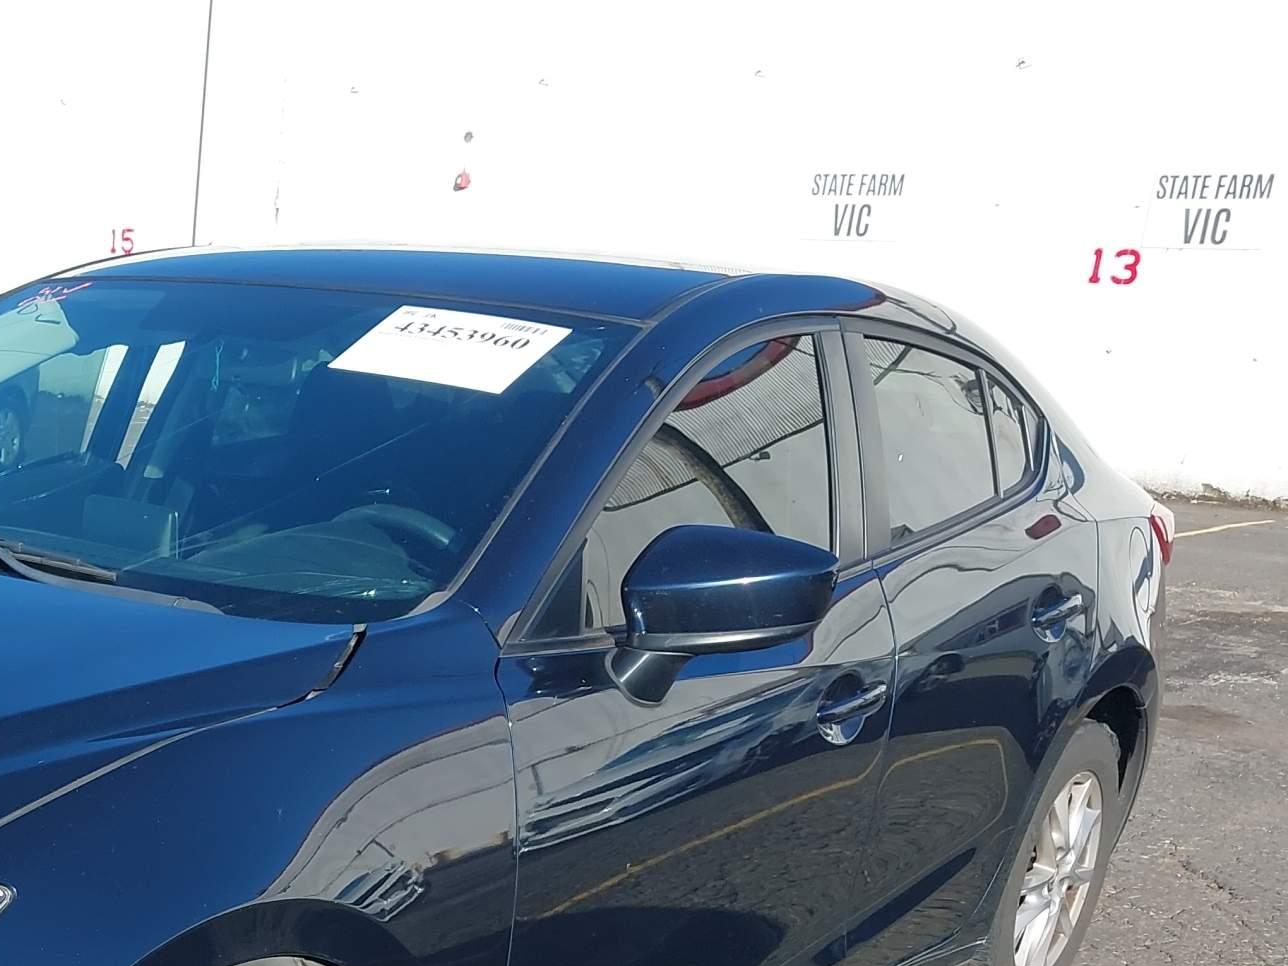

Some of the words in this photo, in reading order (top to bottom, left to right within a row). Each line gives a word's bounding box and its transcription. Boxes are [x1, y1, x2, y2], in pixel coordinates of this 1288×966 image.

[811, 173, 856, 196] STATE
[858, 173, 905, 196] FARM
[1156, 175, 1212, 200] STATE
[1214, 173, 1275, 200] FARM
[833, 203, 872, 237] VIC
[1183, 207, 1232, 245] VIC
[110, 228, 134, 254] 15
[1088, 248, 1141, 285] 13
[394, 321, 531, 350] 43453960
